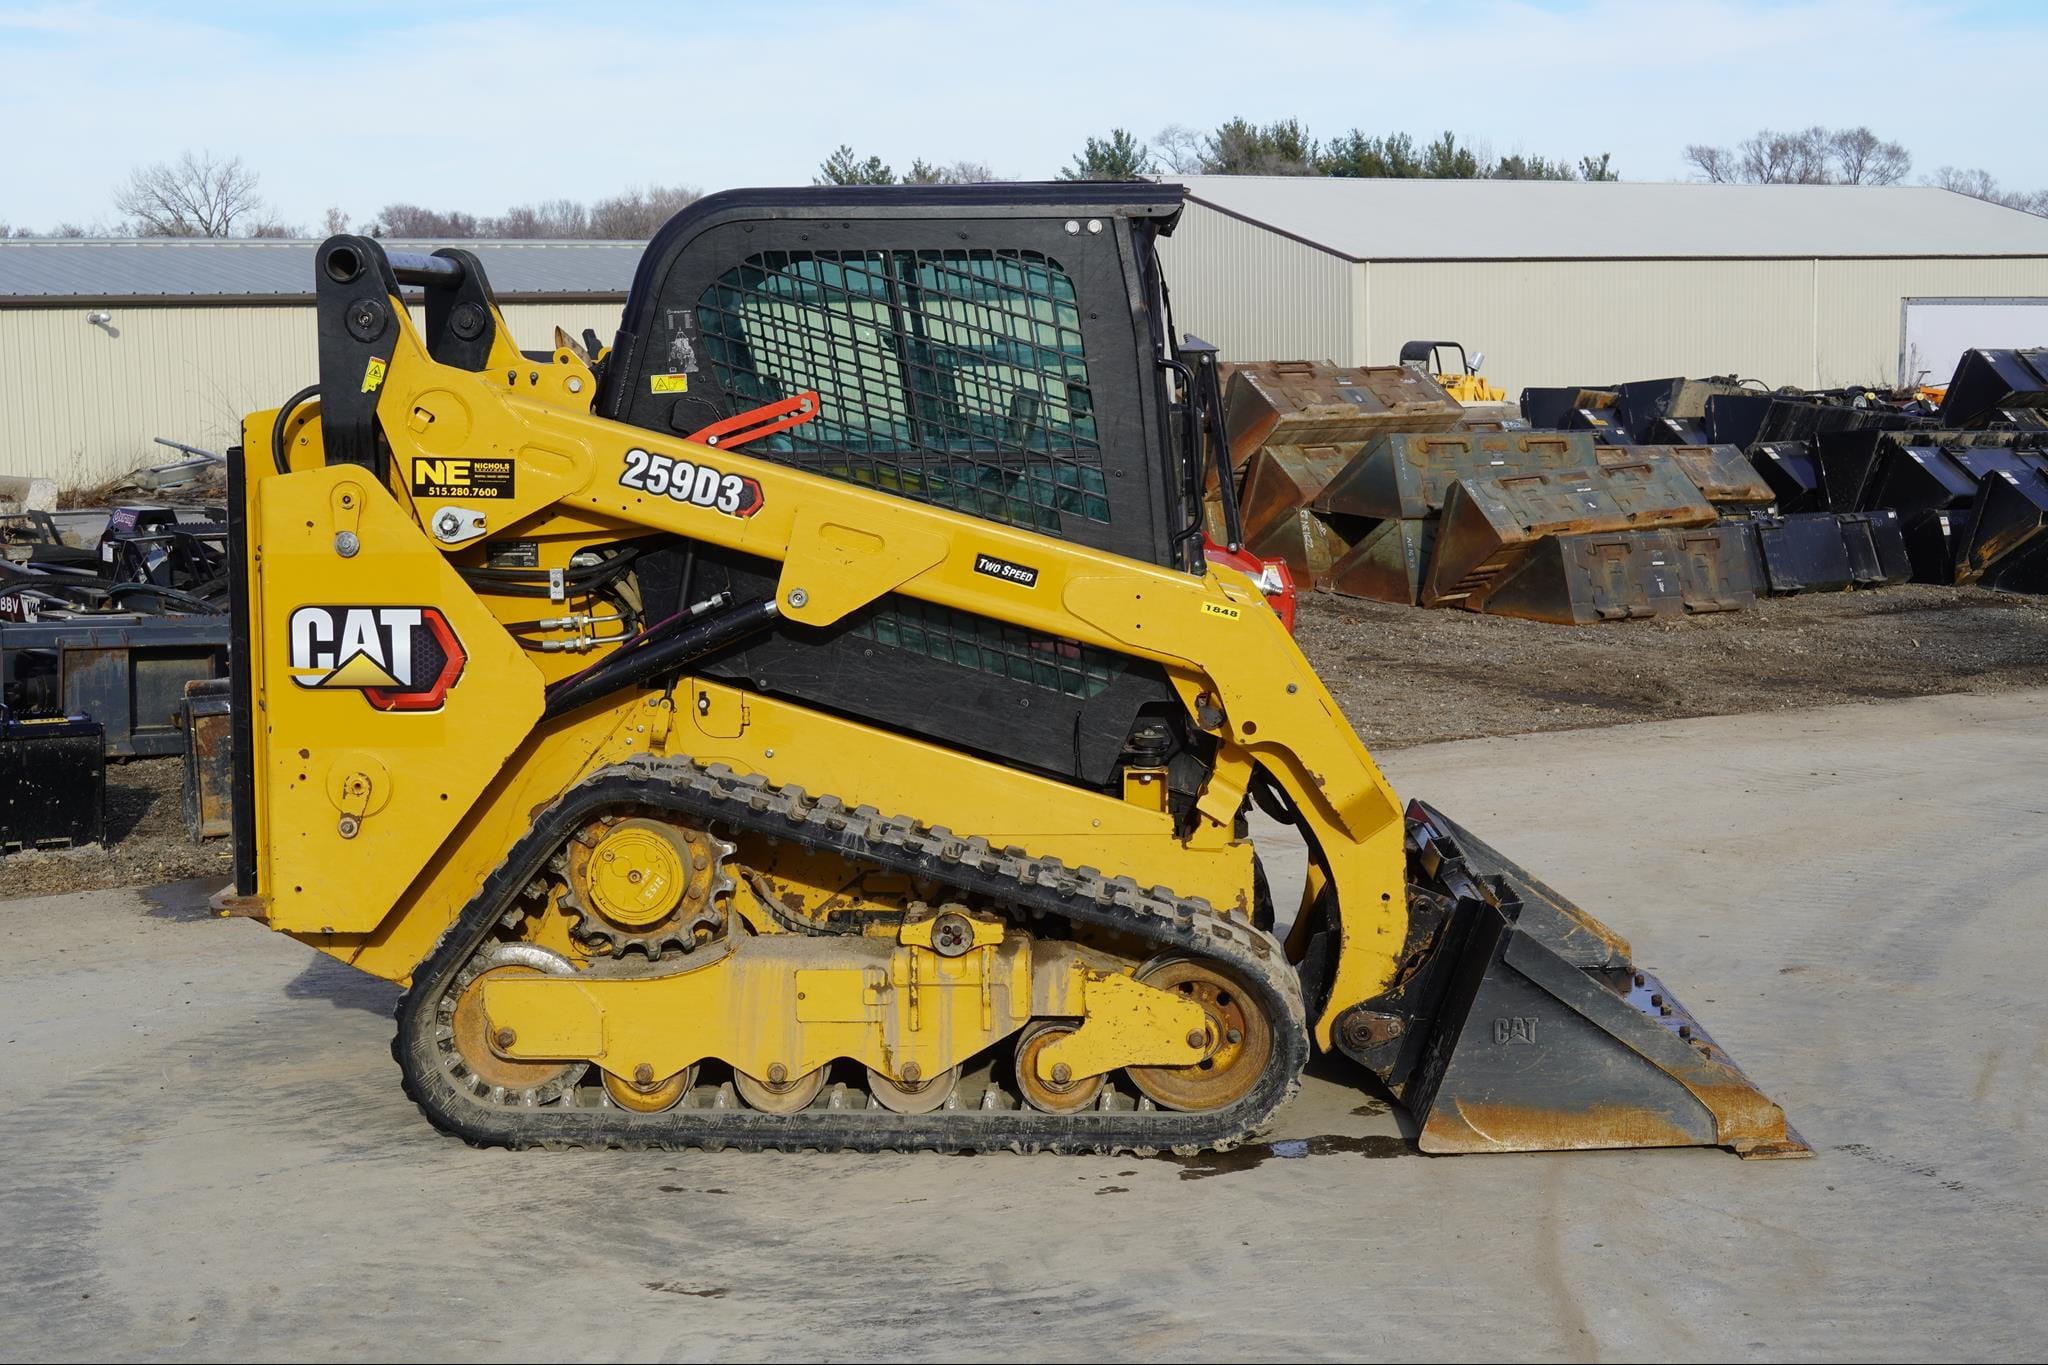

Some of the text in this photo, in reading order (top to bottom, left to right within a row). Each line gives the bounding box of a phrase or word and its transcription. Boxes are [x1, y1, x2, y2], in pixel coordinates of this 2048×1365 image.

[416, 460, 471, 486] NE
[474, 462, 510, 470] NICHOLS
[428, 487, 498, 497] 515.280.7600
[621, 449, 743, 512] 259D3
[1206, 604, 1238, 618] 1848
[292, 608, 422, 686] CAT
[1494, 1017, 1539, 1045] CAT
